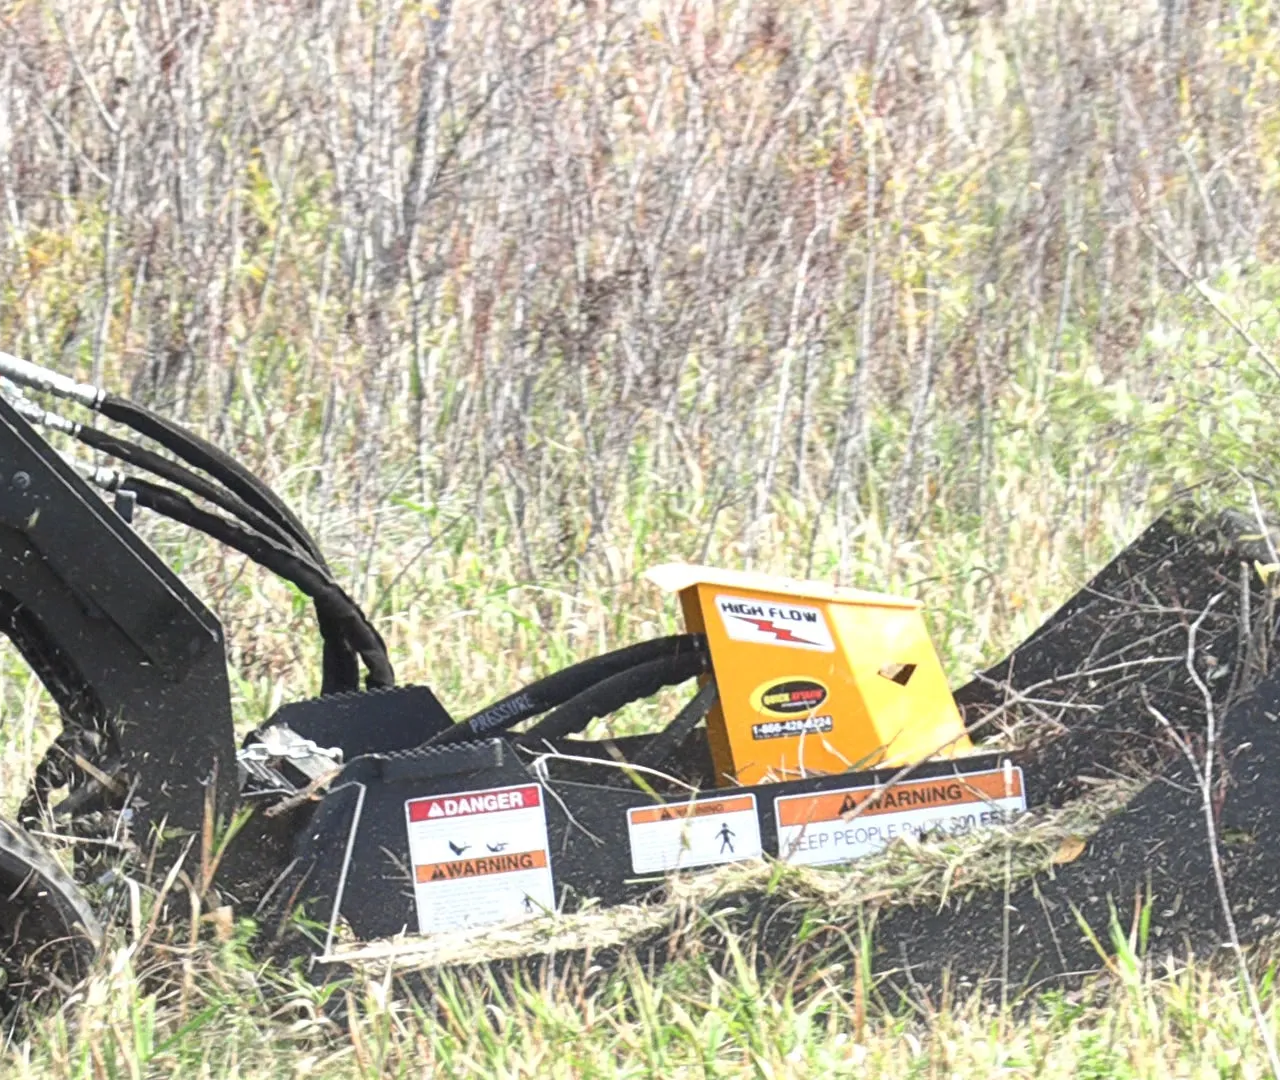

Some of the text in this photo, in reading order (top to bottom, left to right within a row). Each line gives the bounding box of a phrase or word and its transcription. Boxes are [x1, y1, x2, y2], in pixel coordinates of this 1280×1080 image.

[721, 602, 818, 623] HIGH FLOW
[444, 791, 524, 816] DANGER
[865, 784, 962, 810] WARNING
[675, 804, 725, 817] WNING
[833, 823, 897, 846] PEOPLE
[446, 853, 533, 878] WARNING
